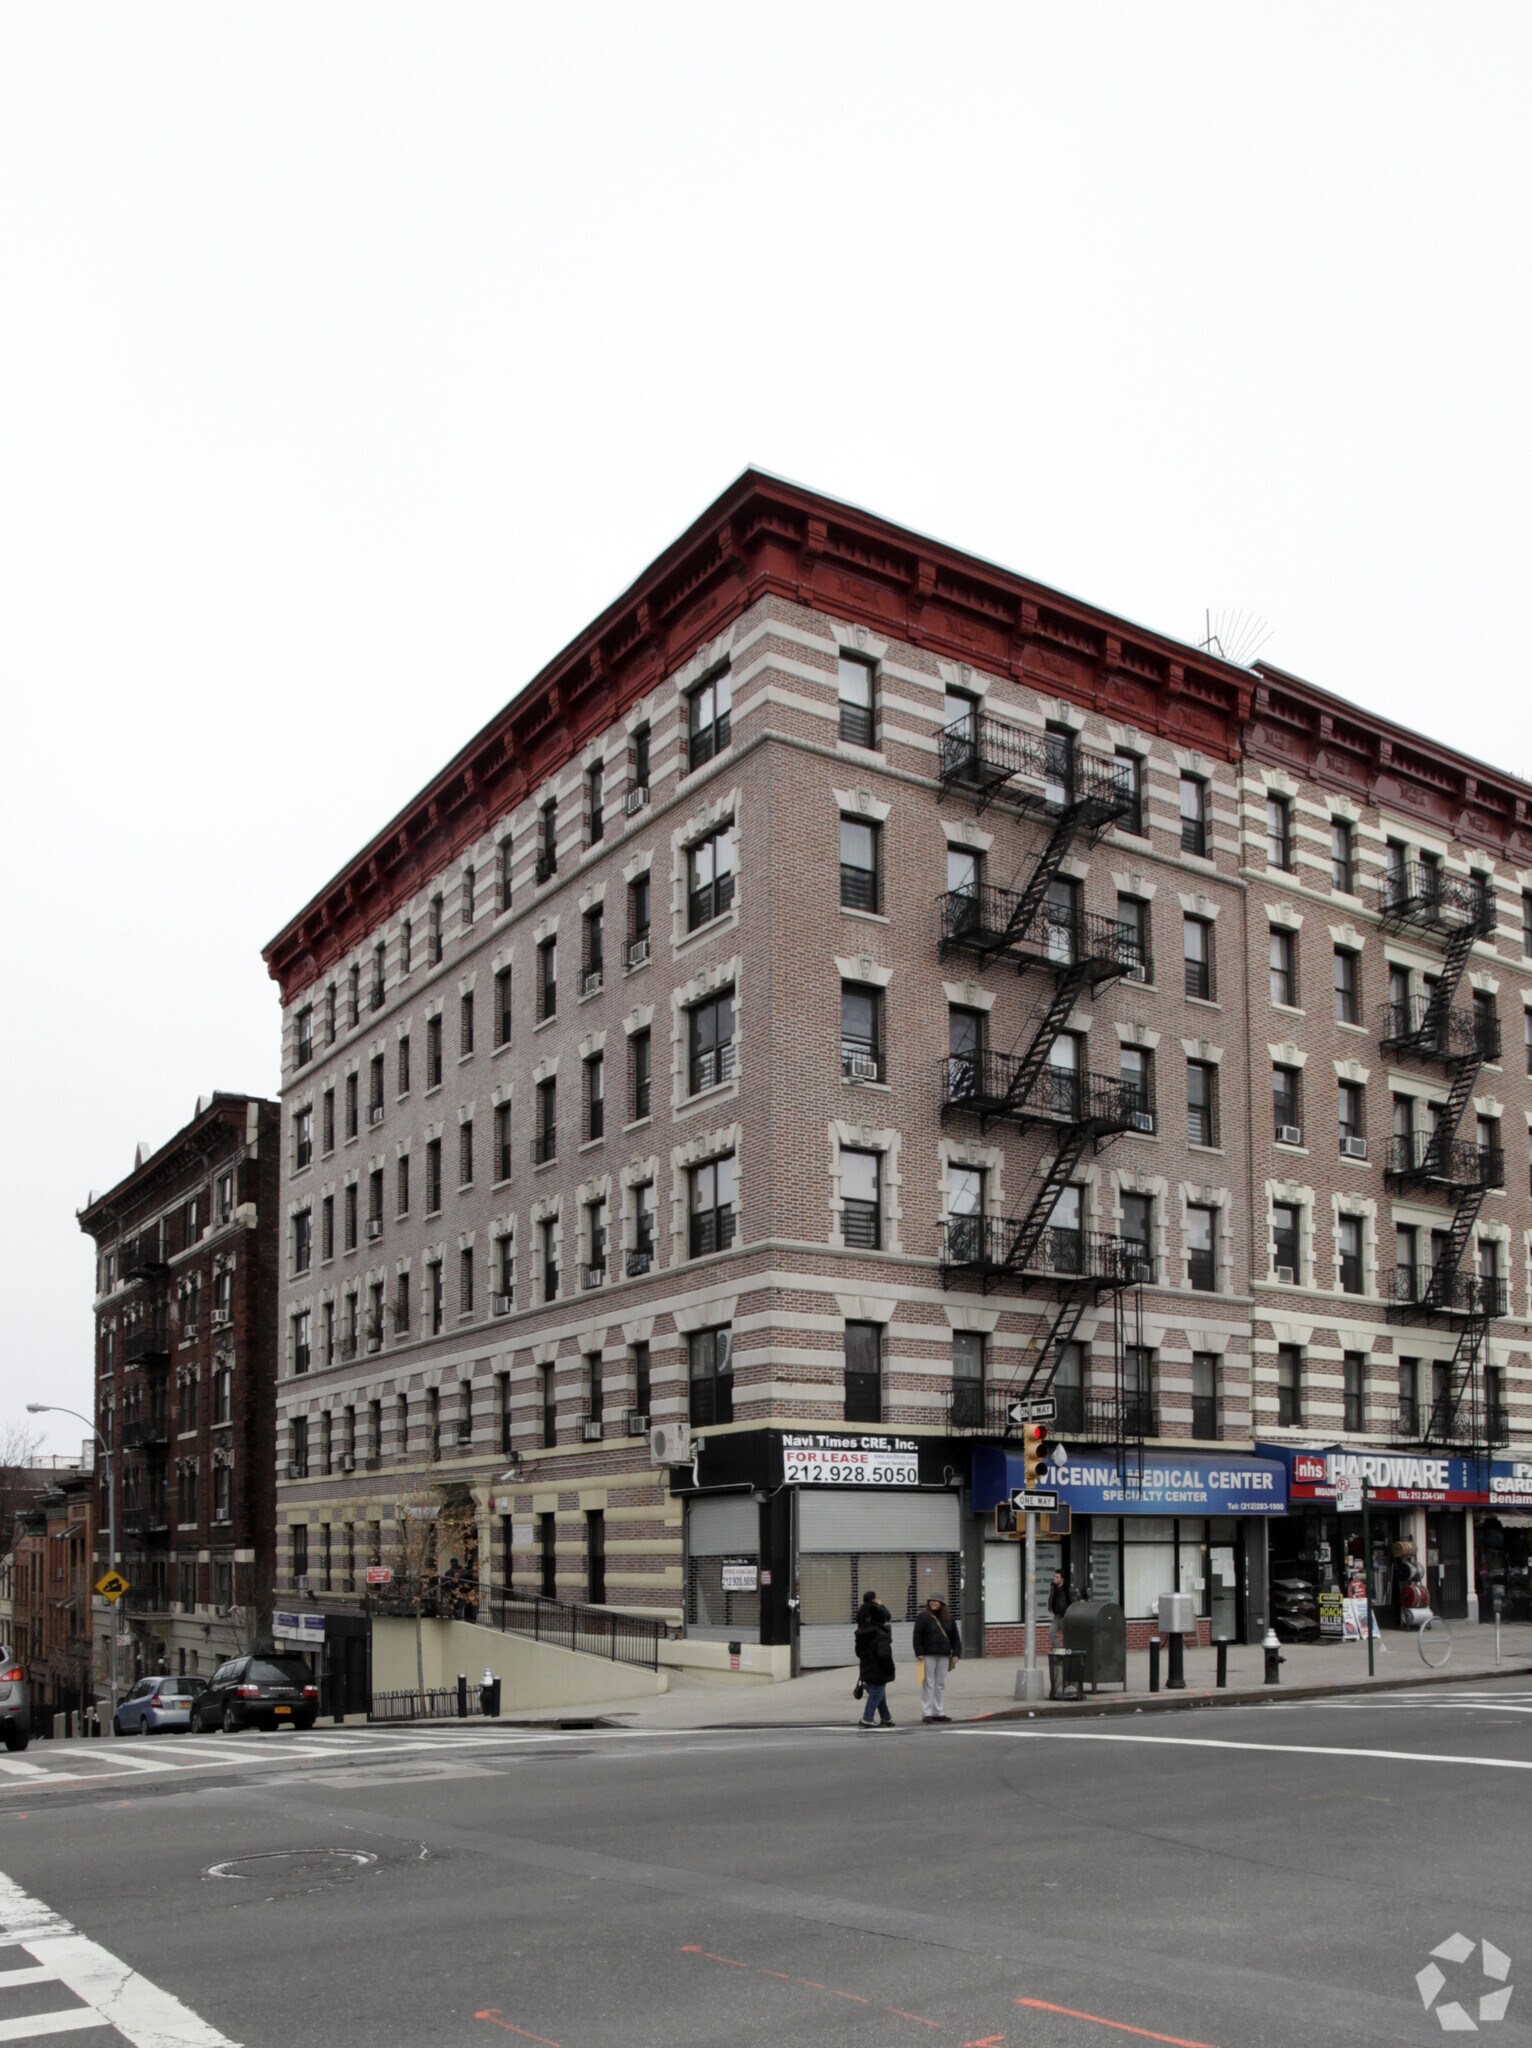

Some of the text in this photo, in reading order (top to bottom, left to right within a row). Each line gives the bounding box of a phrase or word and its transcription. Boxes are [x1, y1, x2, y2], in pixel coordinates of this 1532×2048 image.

[1036, 1405, 1051, 1415] WAY
[782, 1434, 919, 1452] Navi Times CRE, Inc.
[786, 1452, 817, 1462] FOR
[822, 1452, 869, 1464] LEASE
[787, 1465, 917, 1483] 212.928.5050
[1299, 1461, 1323, 1479] nhs
[1326, 1453, 1450, 1490] HARDWARE
[1024, 1466, 1274, 1490] VICENNA MEDICAL CENTER
[1020, 1496, 1052, 1506] ONE WAY
[1102, 1489, 1208, 1502] SPECIALTY CENTER
[1397, 1490, 1410, 1499] TEL:
[1411, 1491, 1421, 1500] 212
[1227, 1502, 1240, 1511] Tel:
[1320, 1607, 1342, 1617] ROACH
[1320, 1616, 1342, 1626] KILLER
